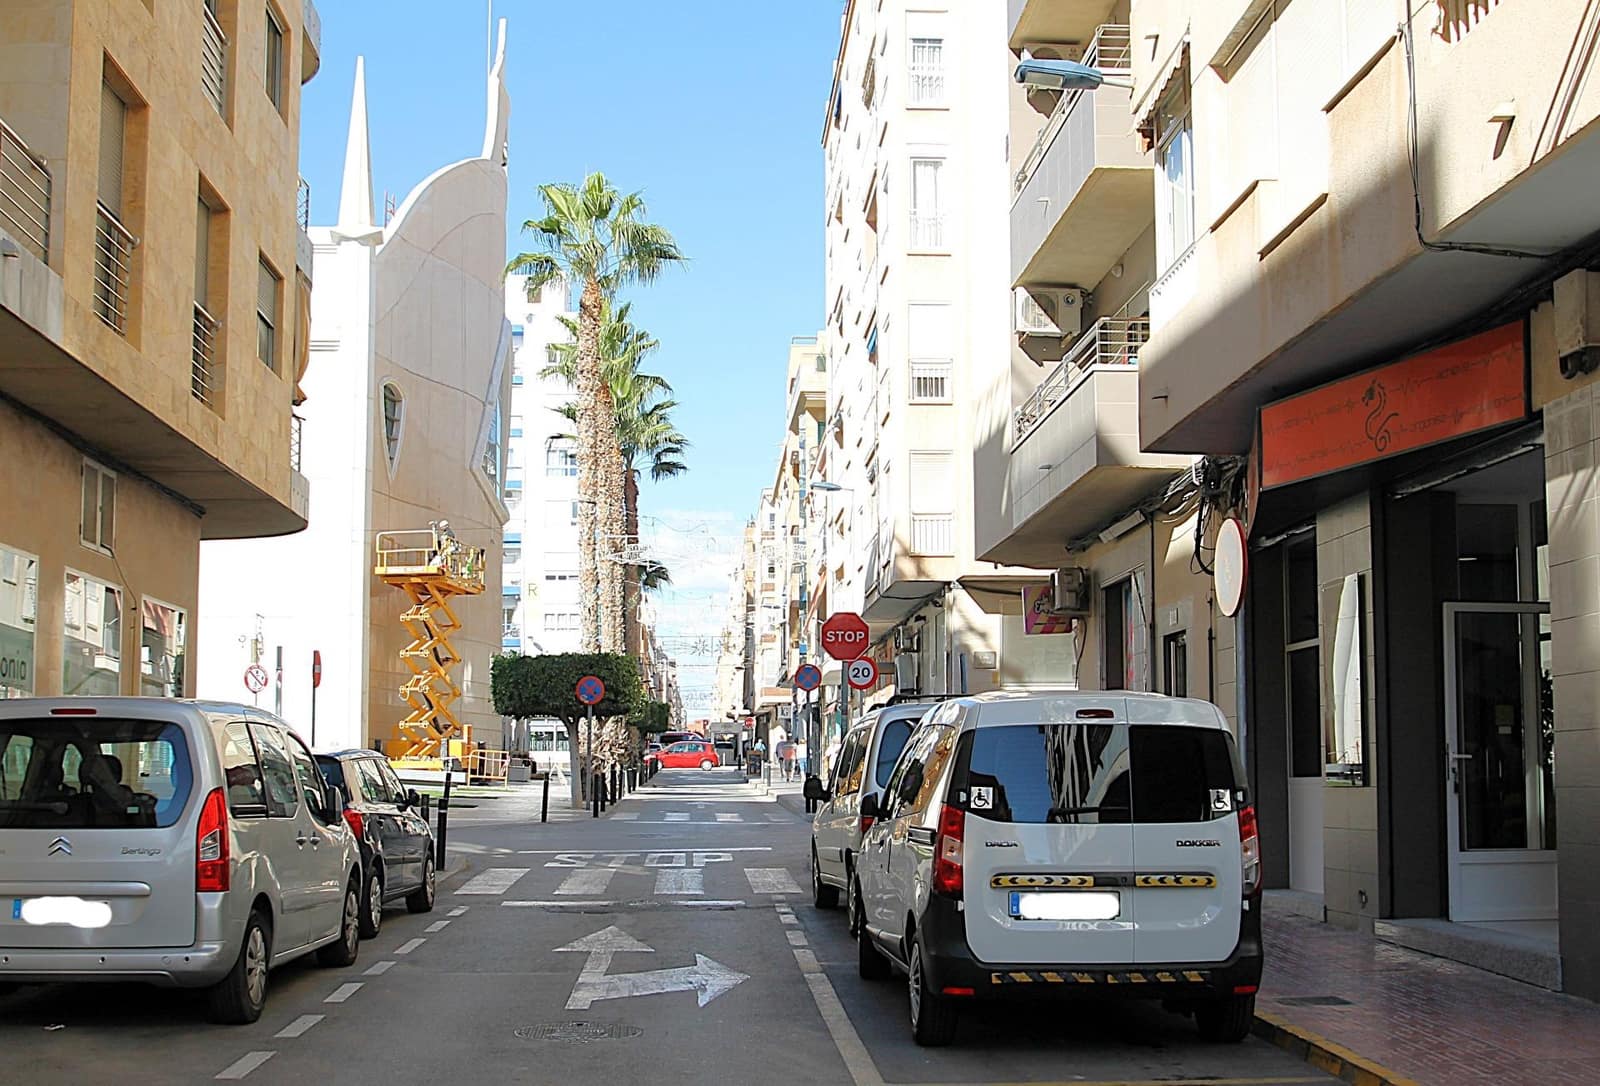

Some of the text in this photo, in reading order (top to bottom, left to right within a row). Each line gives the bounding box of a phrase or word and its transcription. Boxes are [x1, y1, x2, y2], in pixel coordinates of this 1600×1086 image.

[826, 630, 865, 643] STOP
[852, 667, 871, 678] 20
[120, 847, 161, 856] Berlingo
[543, 852, 734, 867] STOP
